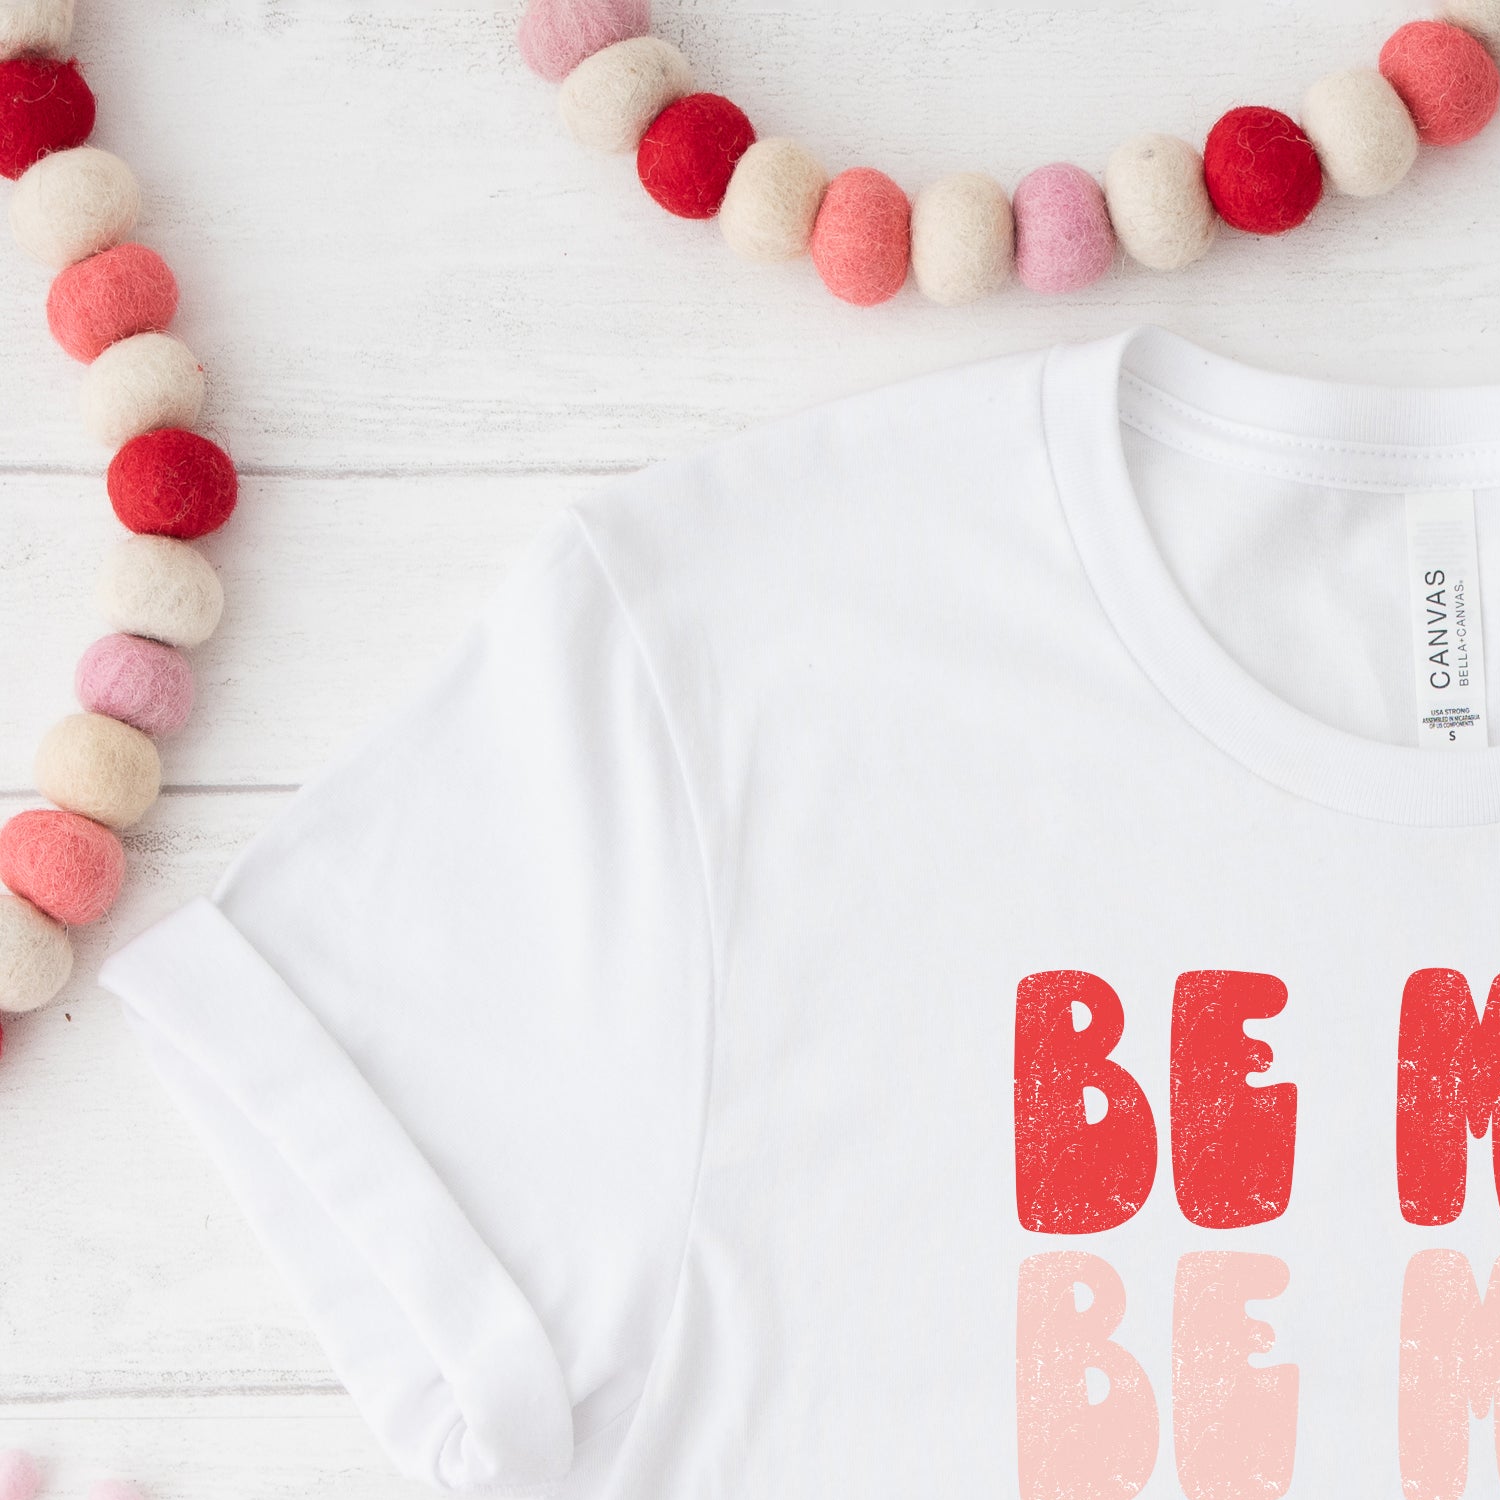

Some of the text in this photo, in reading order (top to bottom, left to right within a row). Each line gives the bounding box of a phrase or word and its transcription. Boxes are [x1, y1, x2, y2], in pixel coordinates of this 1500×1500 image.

[1424, 569, 1451, 689] CANVAS
[1449, 730, 1456, 741] S
[1014, 968, 1299, 1236] BE
